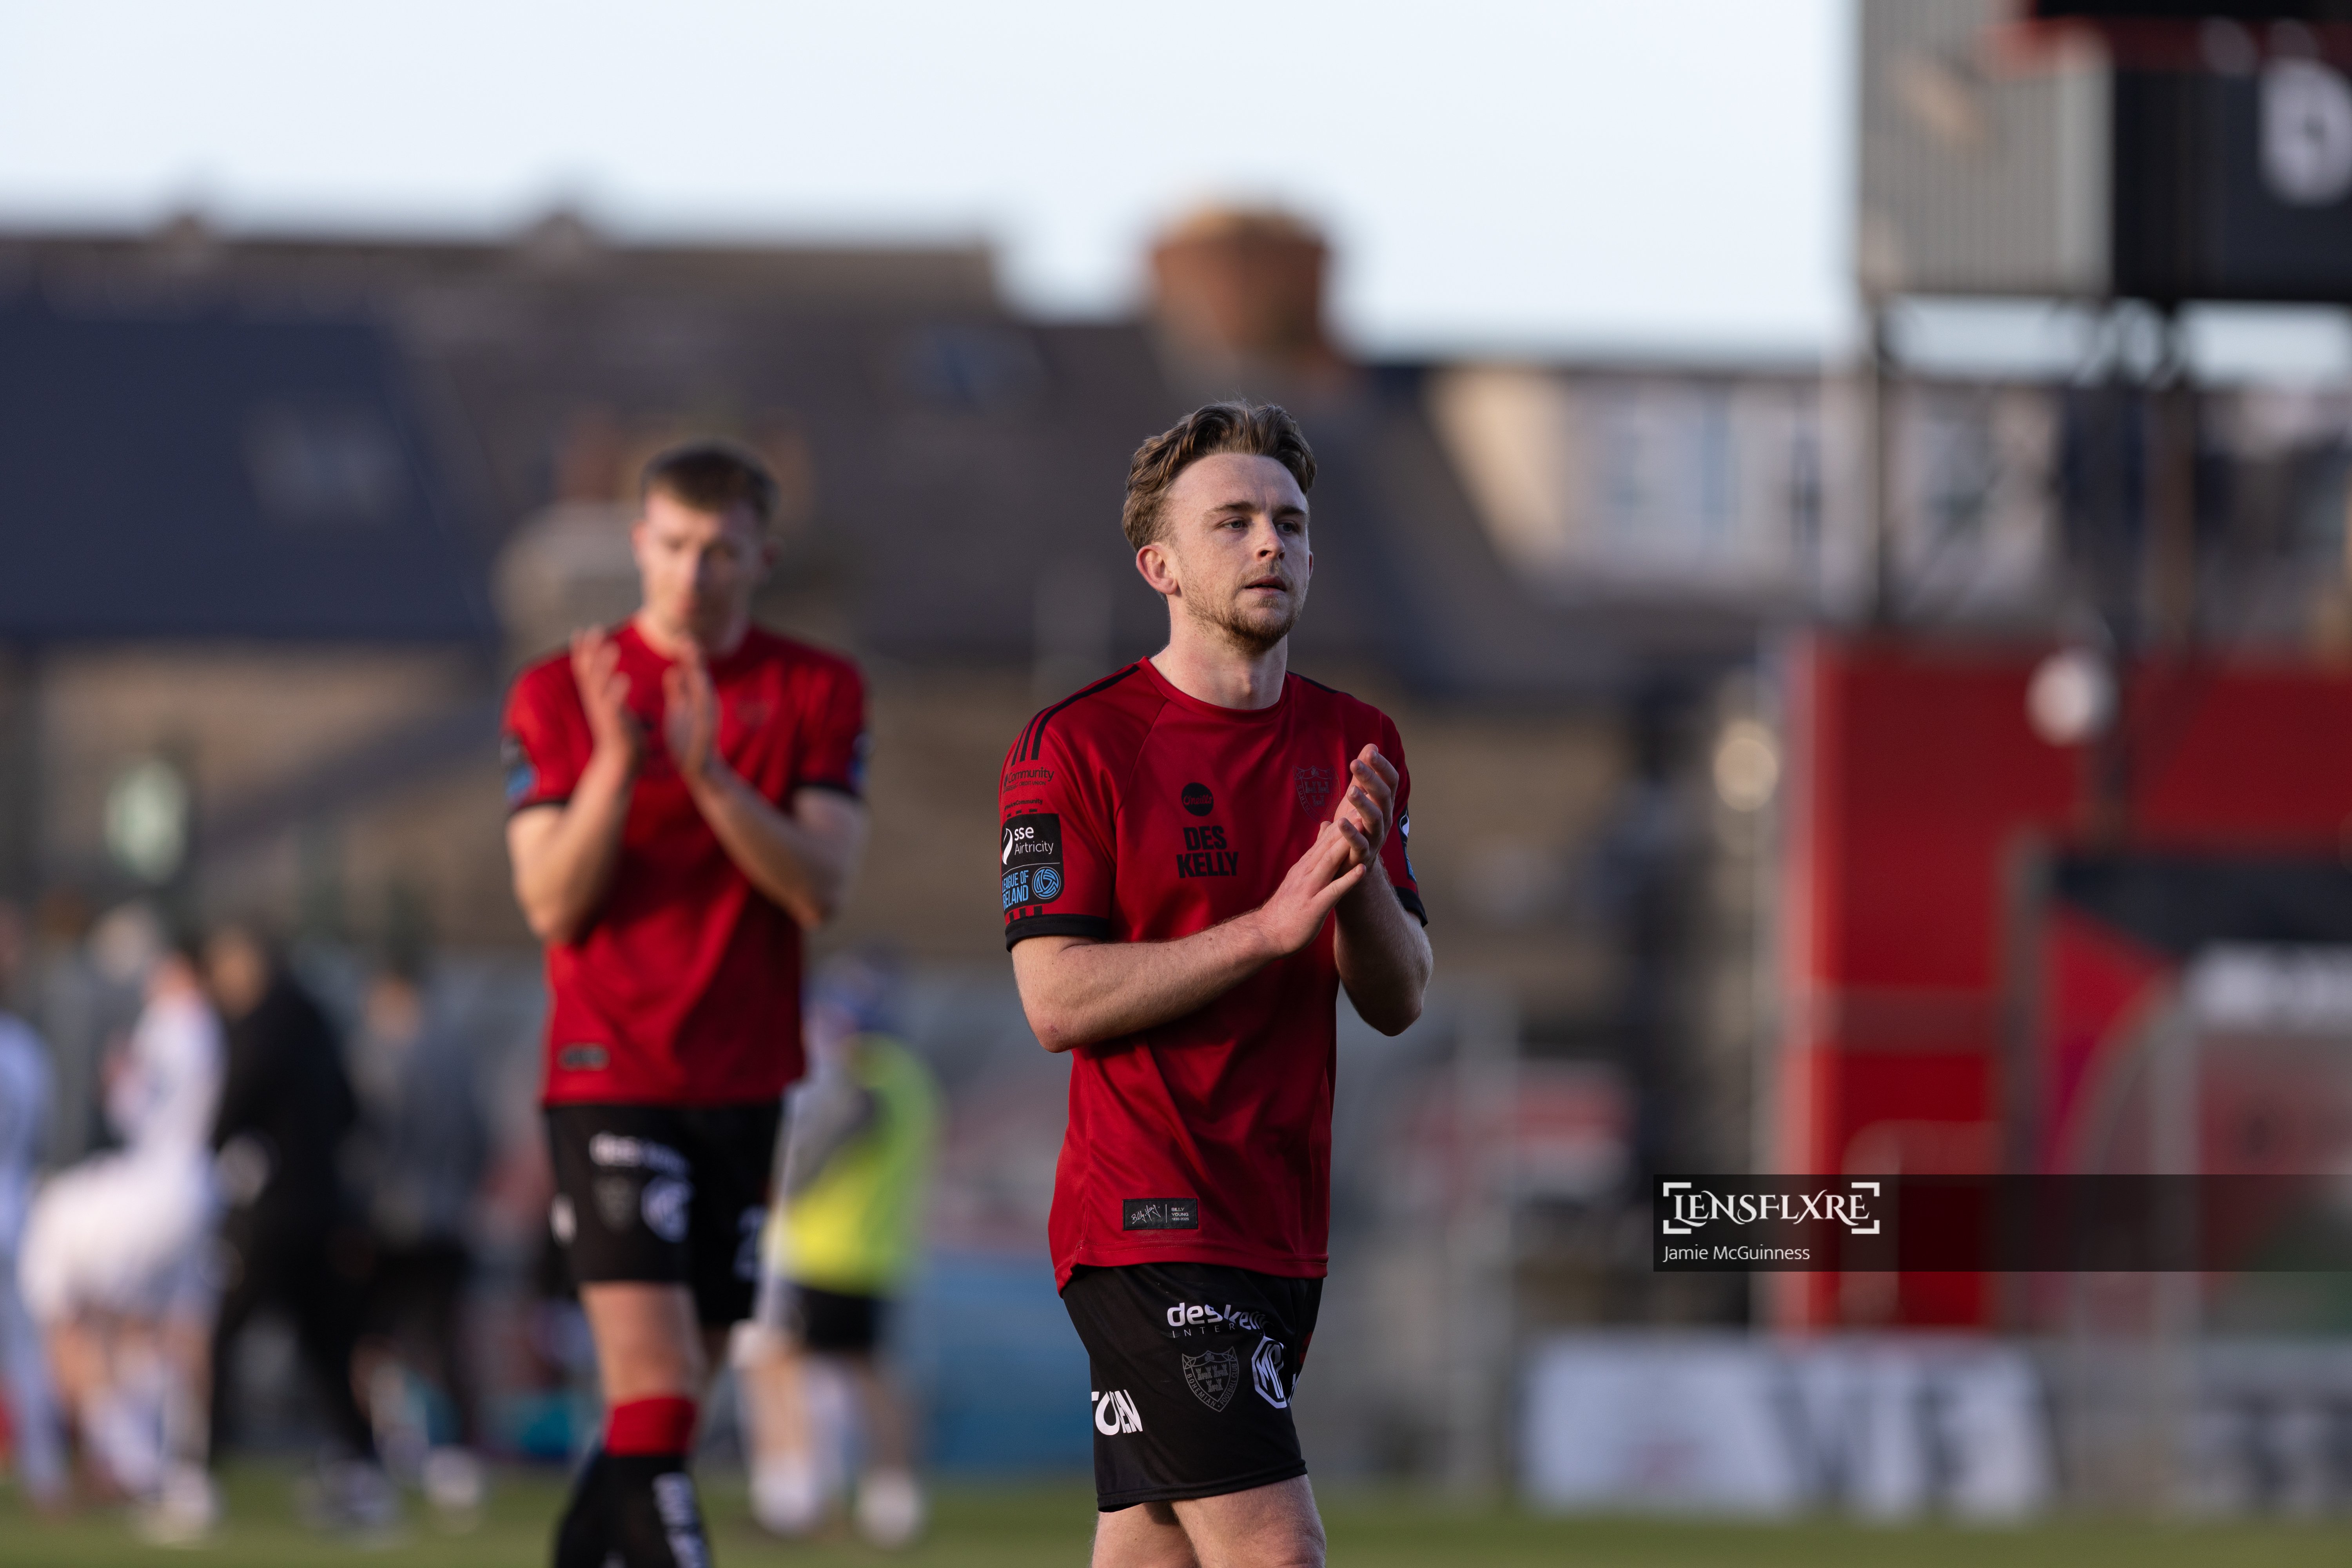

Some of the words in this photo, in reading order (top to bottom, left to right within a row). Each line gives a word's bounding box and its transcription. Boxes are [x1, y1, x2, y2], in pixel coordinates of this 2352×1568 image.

[1008, 766, 1054, 783] Community
[1014, 827, 1034, 841] sse
[1183, 825, 1227, 851] DES
[1014, 840, 1054, 855] Airtricity
[1176, 851, 1239, 878] KELLY
[1002, 872, 1019, 893] LEAGUE
[1020, 870, 1029, 884] OF
[1187, 1373, 1216, 1407] BOHEMIAN
[1220, 1379, 1236, 1405] FOOTBALL
